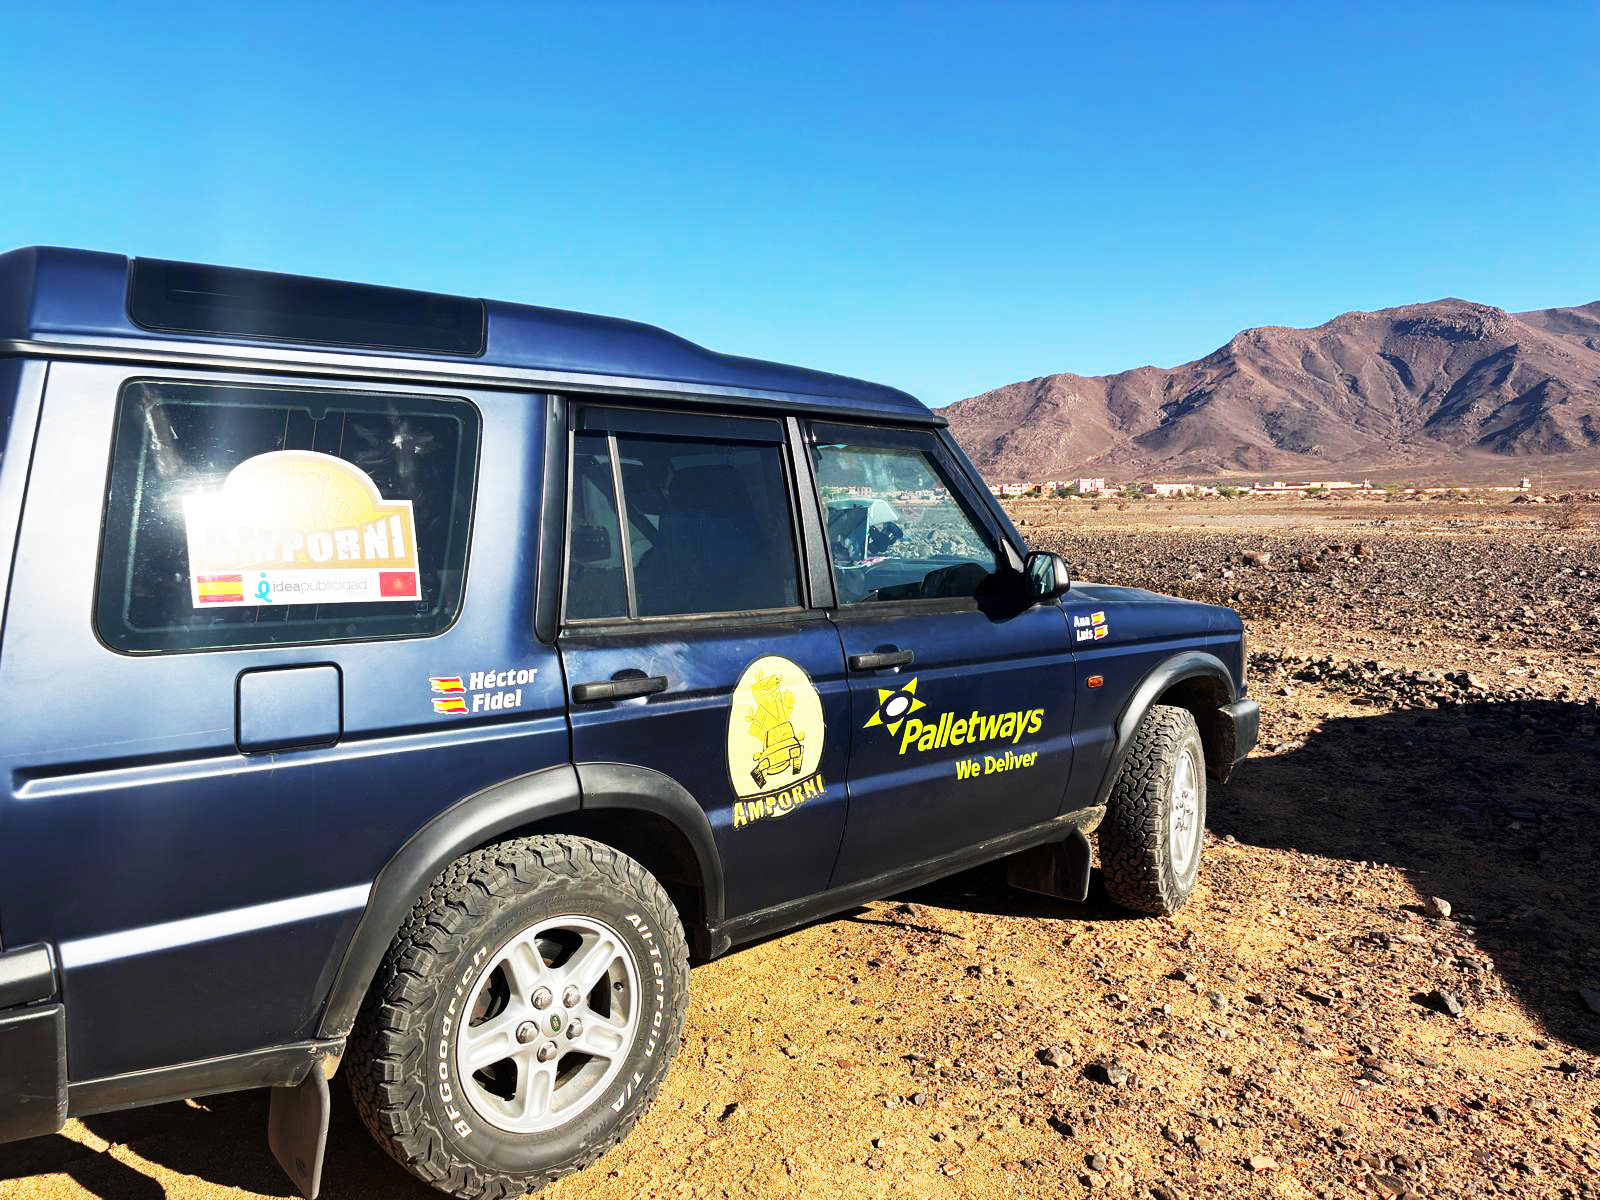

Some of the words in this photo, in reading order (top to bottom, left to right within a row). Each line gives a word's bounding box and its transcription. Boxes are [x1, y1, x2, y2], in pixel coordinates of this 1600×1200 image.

[272, 578, 367, 594] ideapublicidad
[1074, 615, 1091, 628] Ana
[1076, 628, 1094, 641] Luis
[469, 668, 538, 691] Héctor
[472, 688, 522, 713] Fidel
[899, 708, 1045, 755] Palletways
[955, 760, 981, 780] We
[984, 750, 1038, 775] Deliver
[733, 773, 826, 829] AMPORNI
[625, 913, 664, 1057] All-Terrain
[438, 946, 487, 1139] BFGoodrich
[610, 1071, 645, 1113] T/A
